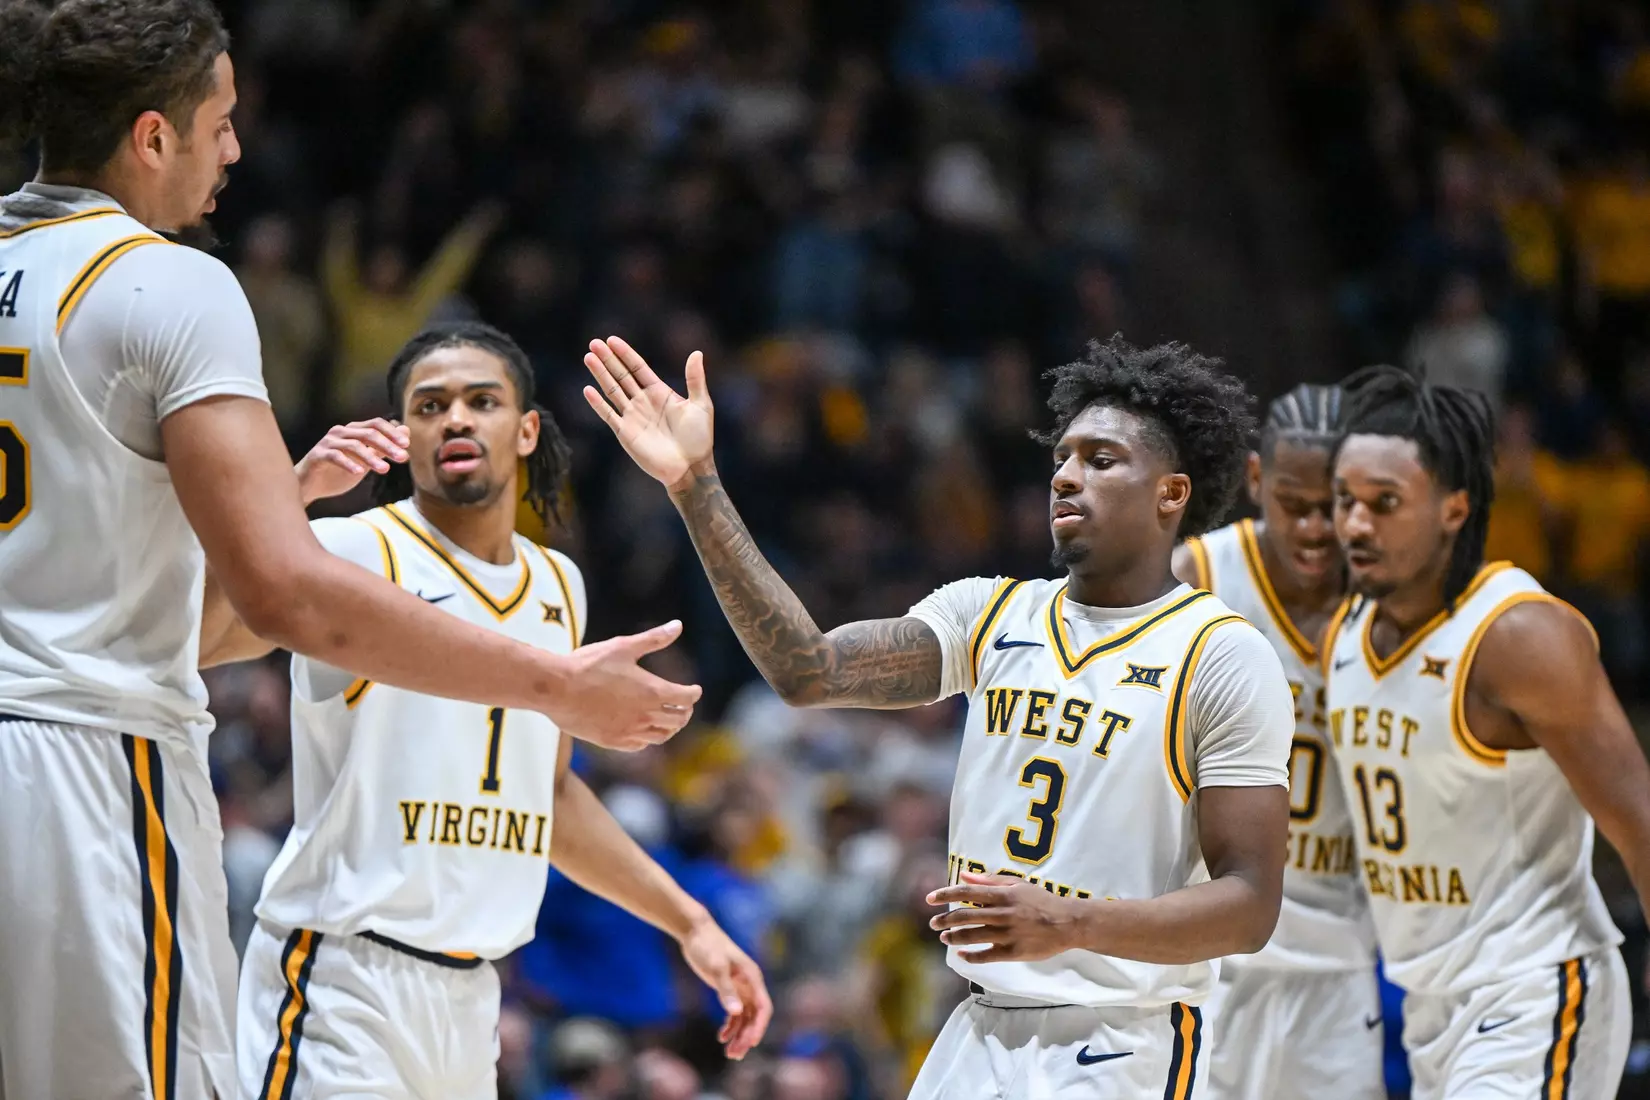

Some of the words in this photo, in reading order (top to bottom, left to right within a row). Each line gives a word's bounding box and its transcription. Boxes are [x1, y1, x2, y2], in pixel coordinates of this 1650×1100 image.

[1117, 662, 1170, 691] XII
[480, 706, 507, 796] 1
[984, 687, 1135, 760] WEST
[398, 800, 547, 857] VIRGINI
[1004, 756, 1068, 866] 3
[1353, 761, 1408, 855] 13
